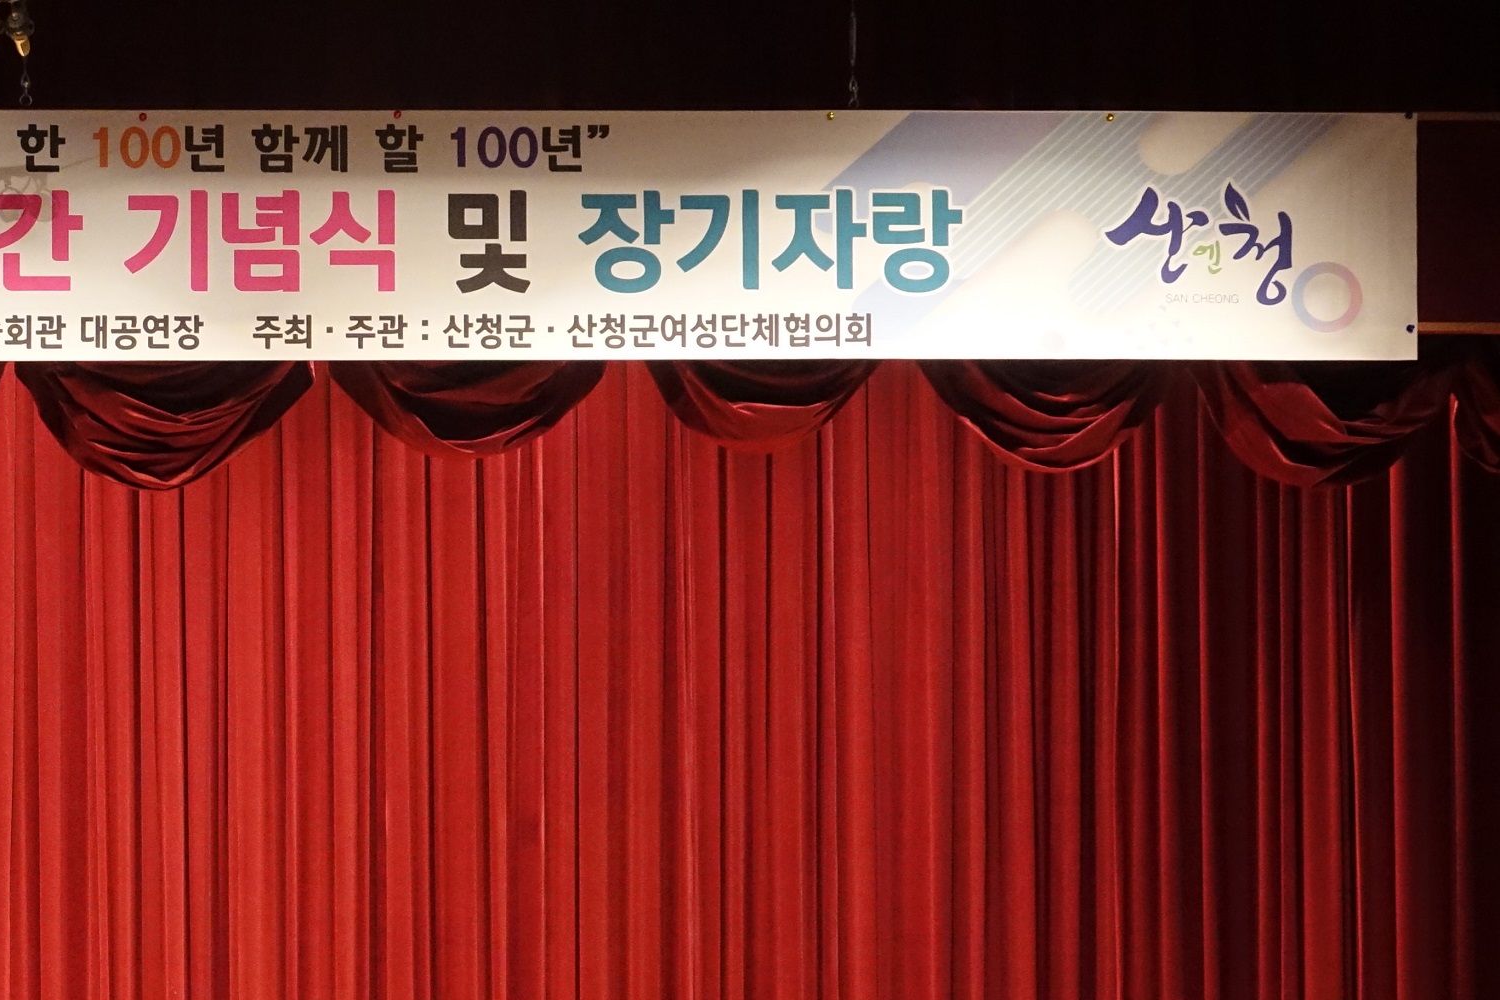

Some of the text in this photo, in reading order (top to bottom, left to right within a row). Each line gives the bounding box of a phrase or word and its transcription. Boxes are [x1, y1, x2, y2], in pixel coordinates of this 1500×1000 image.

[17, 124, 65, 172] 한
[93, 124, 224, 172] 100년
[252, 124, 347, 172] 함께
[375, 124, 423, 173] 할
[124, 190, 395, 291] 기념식
[448, 190, 530, 293] 및
[578, 190, 962, 293] 장기자랑
[1165, 293, 1240, 304] SAN CHEONG
[81, 315, 204, 350] 대공연장
[253, 315, 312, 349] 주최
[346, 315, 408, 349] 주관
[443, 314, 534, 349] 산청군
[567, 313, 872, 348] 산청군여성단체협의회
